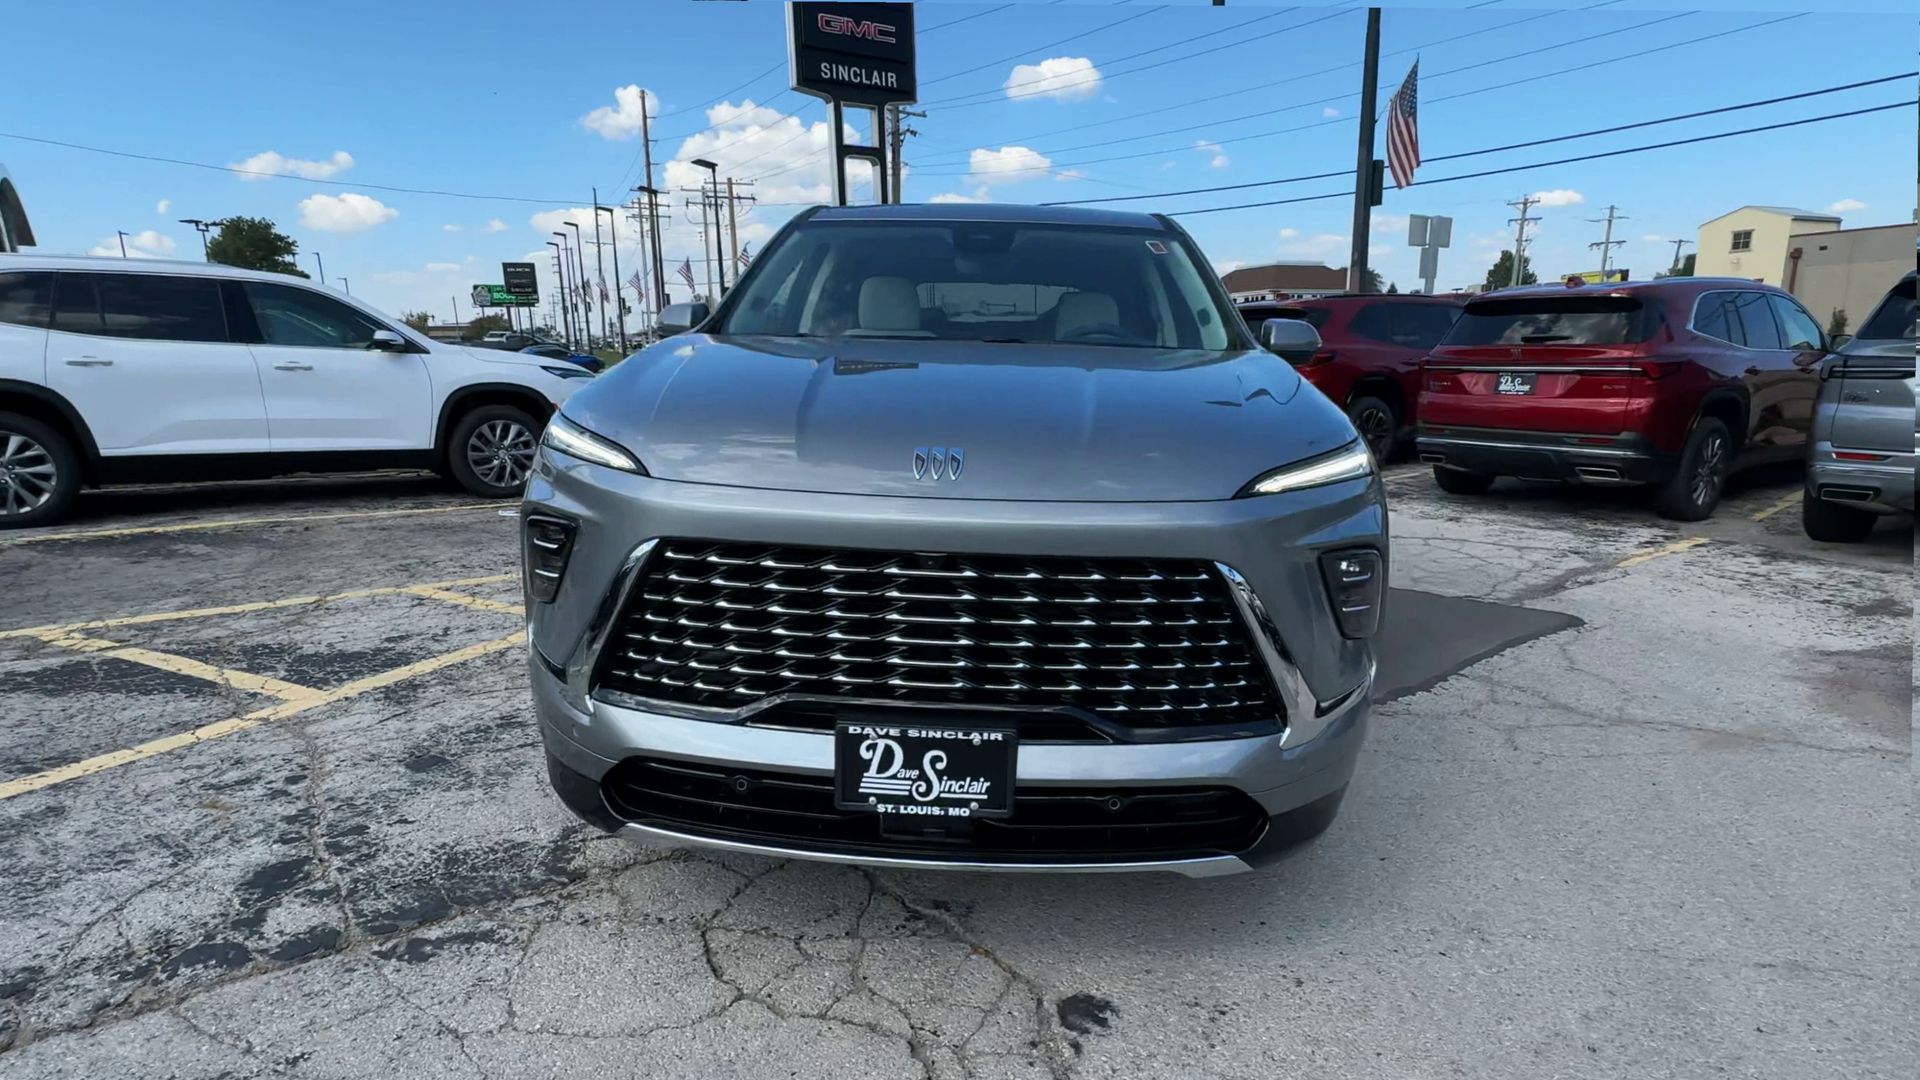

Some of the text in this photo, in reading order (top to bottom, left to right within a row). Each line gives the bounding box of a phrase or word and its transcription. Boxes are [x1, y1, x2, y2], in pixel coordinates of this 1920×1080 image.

[817, 13, 896, 44] GMC
[820, 62, 897, 88] SINCLAIR
[848, 726, 1003, 741] DAVE SINCLAIR
[859, 738, 991, 801] Dave Sinclair
[876, 804, 896, 813] ST.
[948, 807, 970, 817] MO
